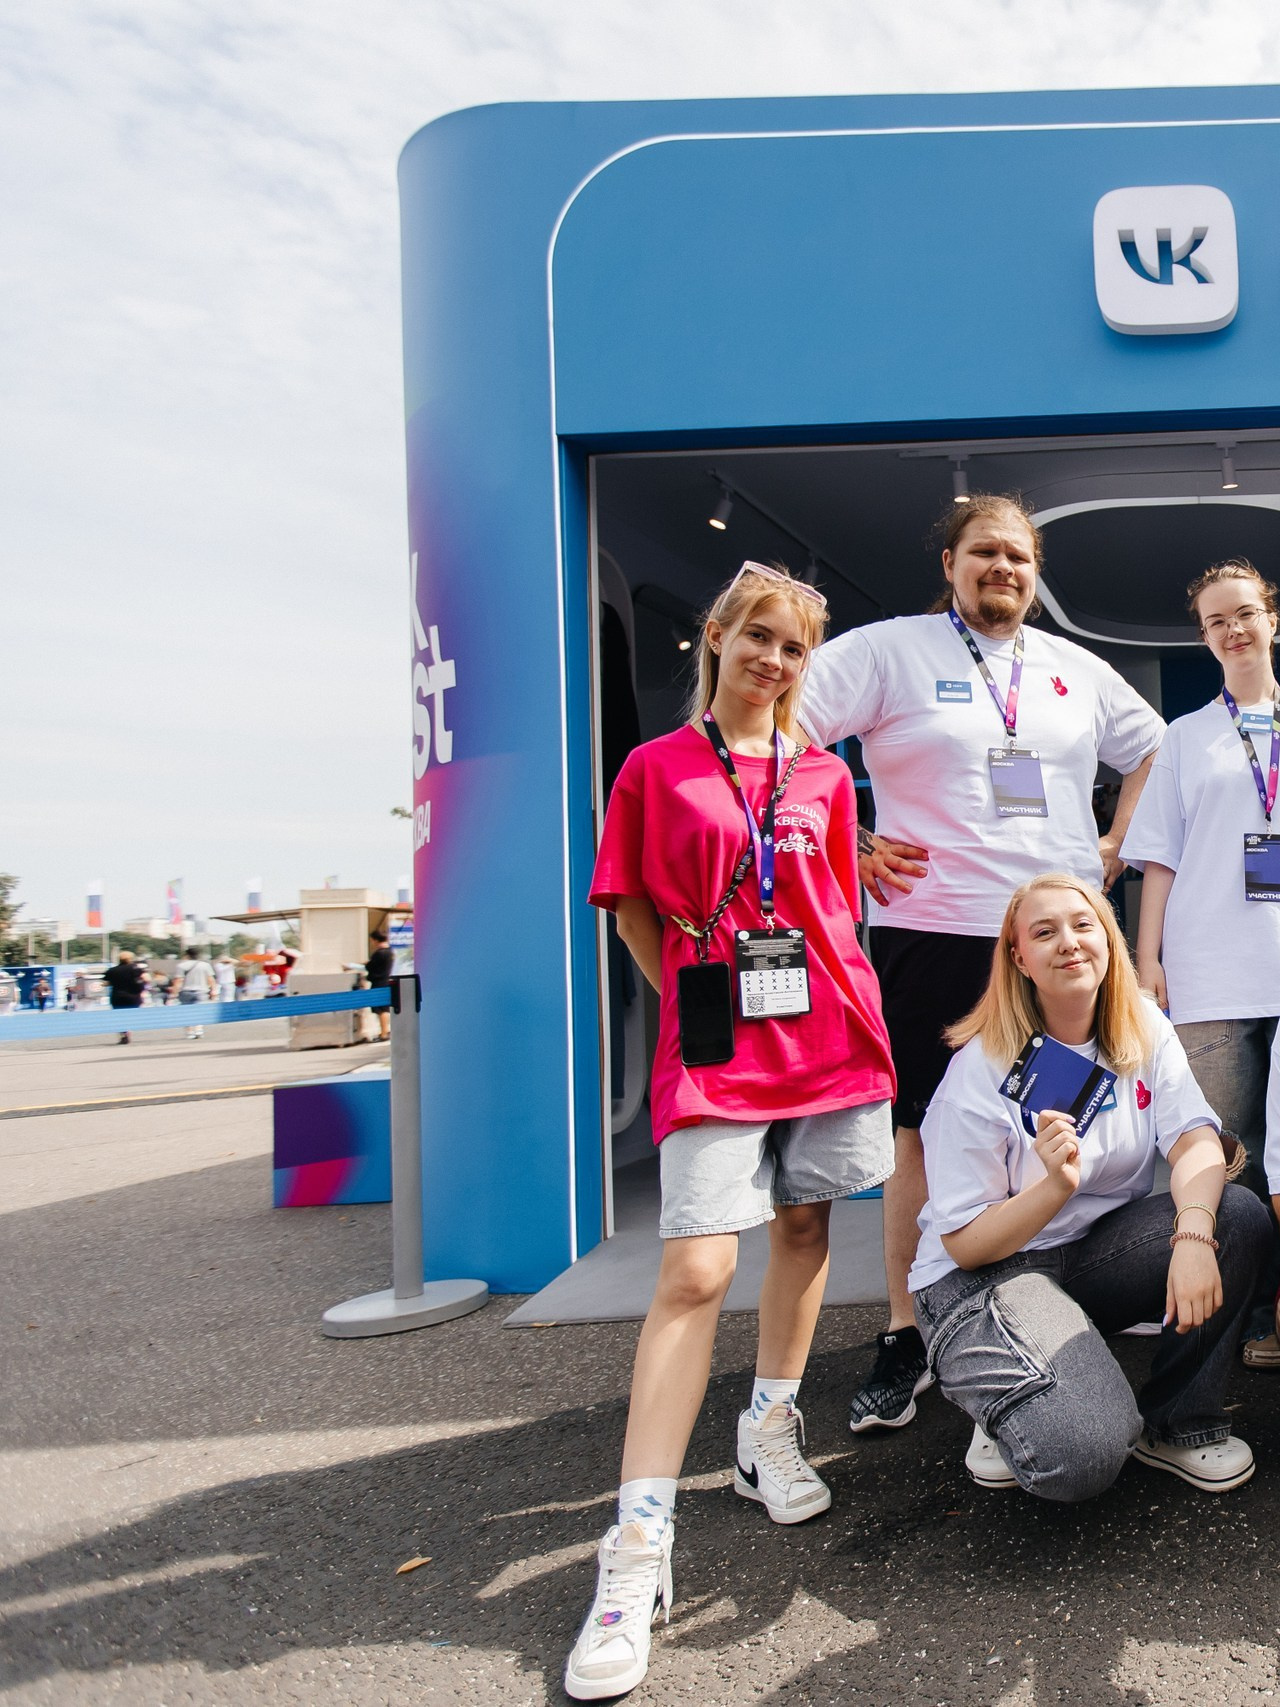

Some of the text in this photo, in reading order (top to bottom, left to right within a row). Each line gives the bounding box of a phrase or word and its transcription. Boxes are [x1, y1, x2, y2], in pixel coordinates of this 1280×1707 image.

[1117, 226, 1210, 286] VK
[999, 806, 1042, 814] УЧАСТНИК
[788, 832, 811, 844] VK
[774, 839, 819, 856] fest
[1075, 1077, 1111, 1132] УЧАСТНИК
